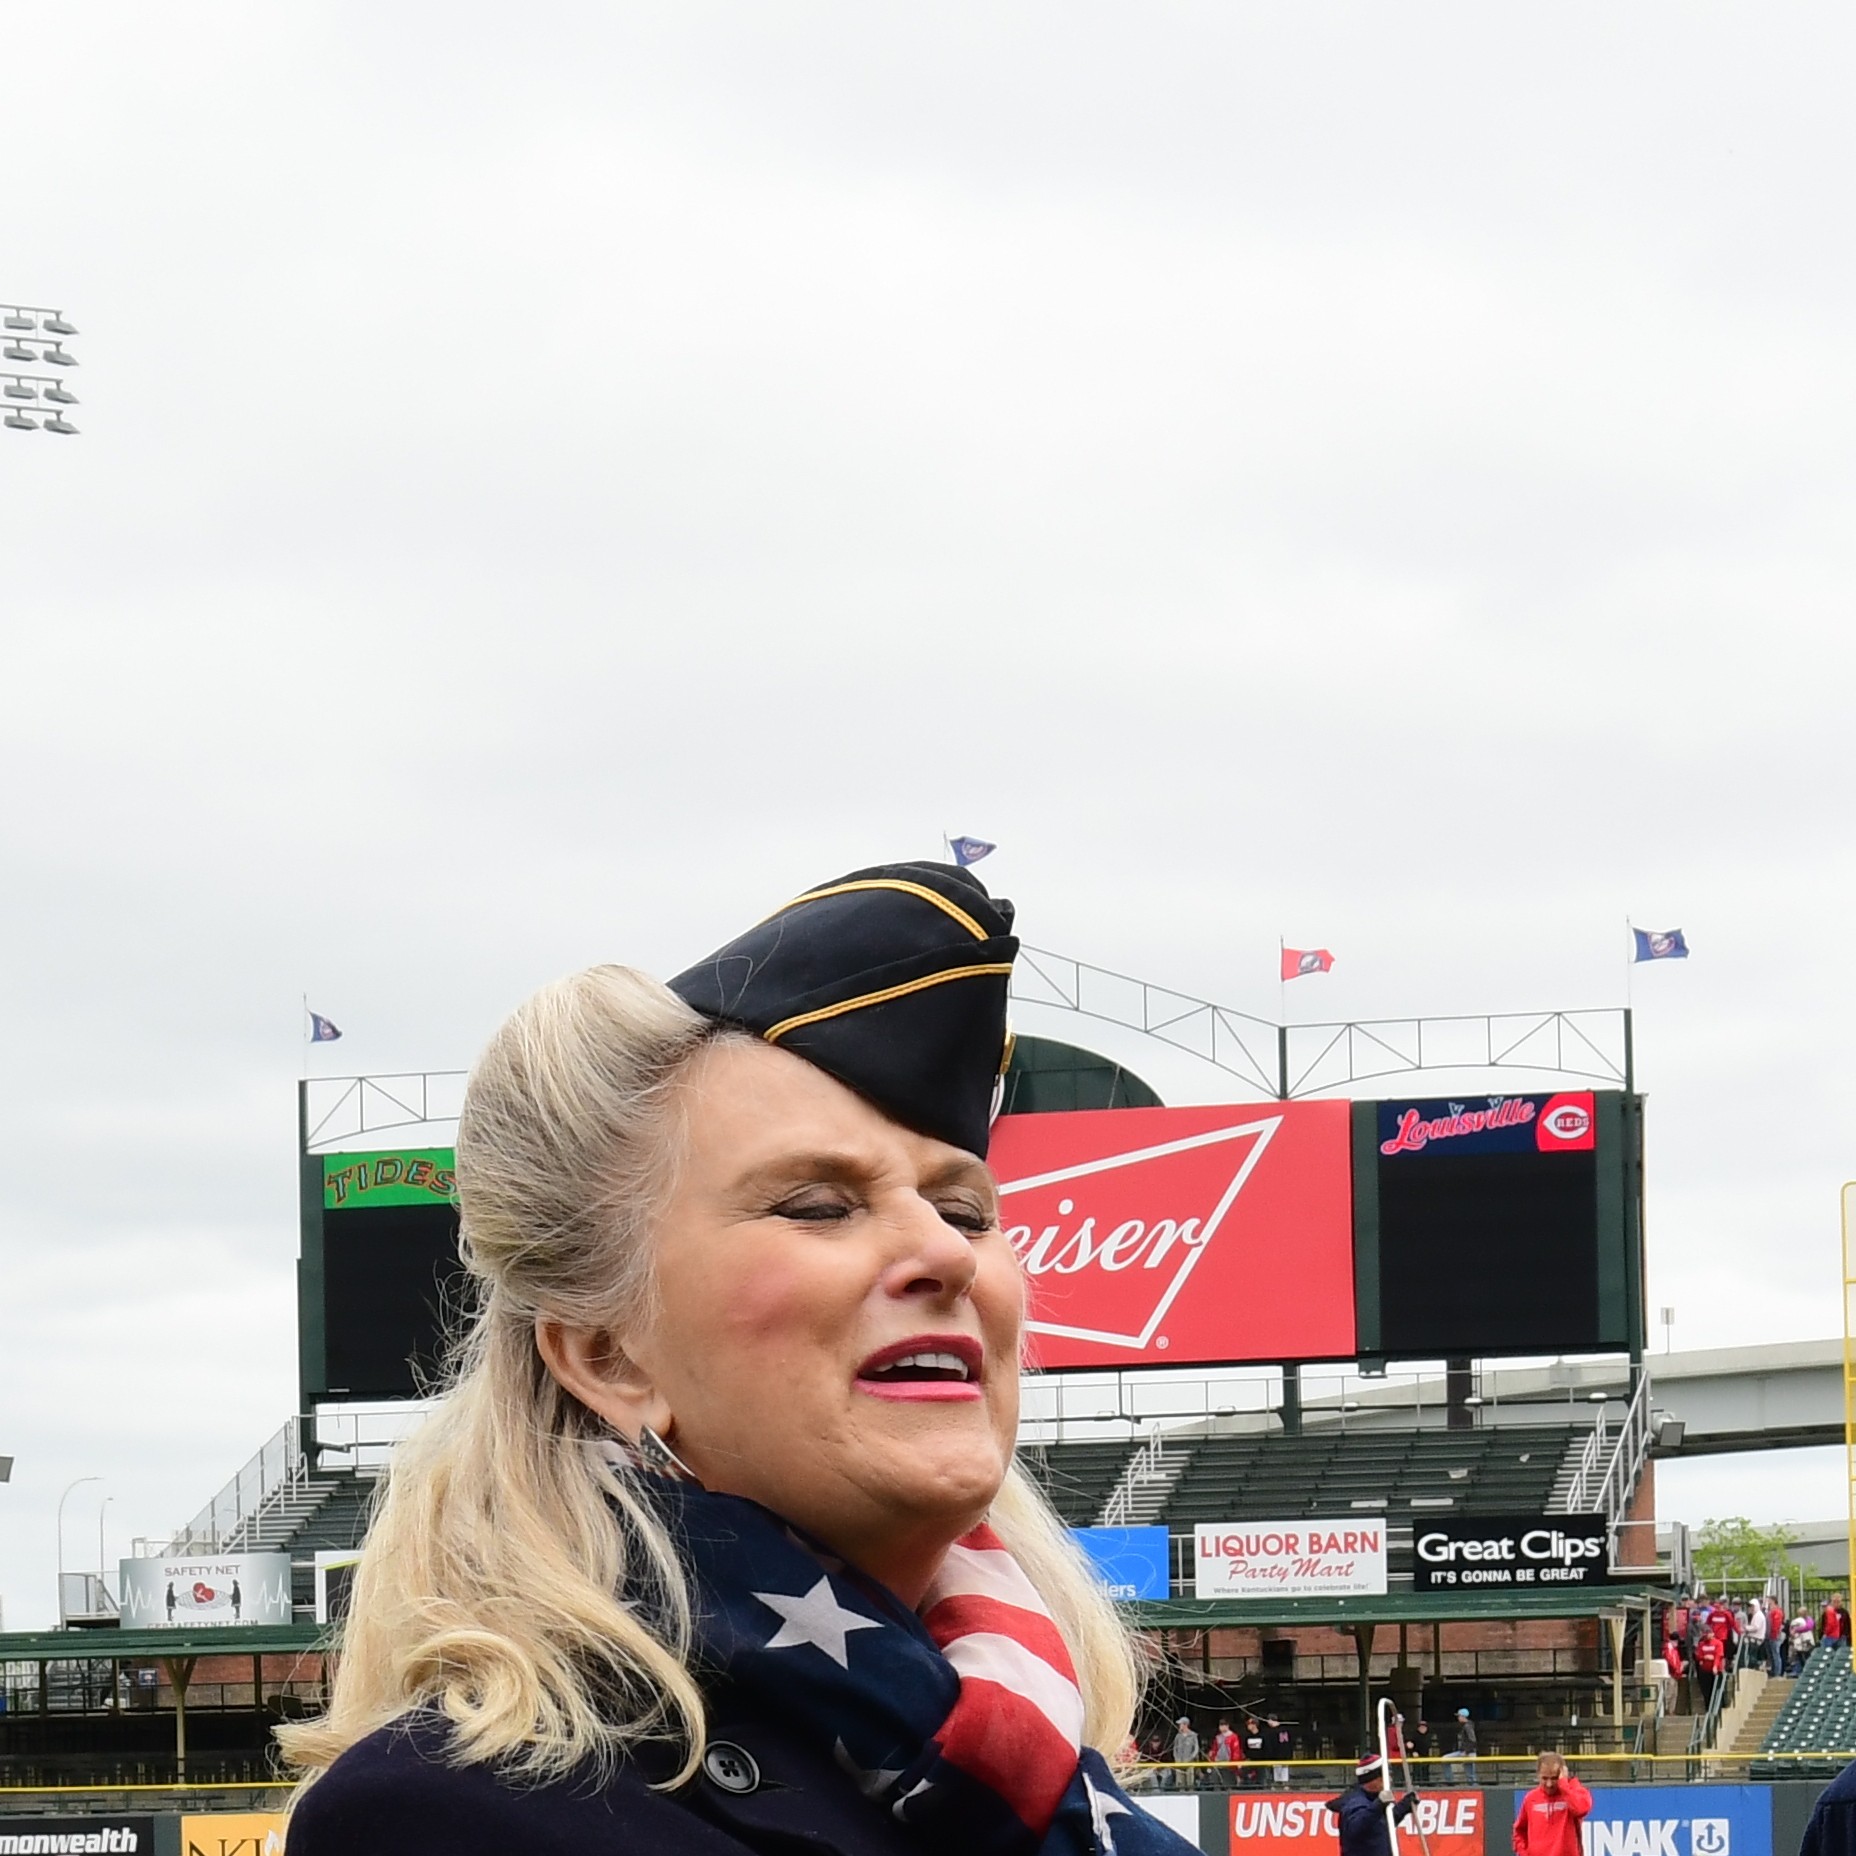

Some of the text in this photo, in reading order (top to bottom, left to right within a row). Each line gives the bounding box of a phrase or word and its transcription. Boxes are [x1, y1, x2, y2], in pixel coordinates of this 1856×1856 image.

[1381, 1098, 1535, 1155] Louisville
[327, 1158, 457, 1204] TIDES
[1003, 1199, 1202, 1275] eiser
[1200, 1531, 1379, 1558] LIQUOR BARN
[1417, 1530, 1601, 1566] Great Clips
[164, 1564, 241, 1577] SAFETY NET
[1228, 1557, 1355, 1583] Party Mart
[1430, 1568, 1584, 1584] IT'S GONNA BE GREAT
